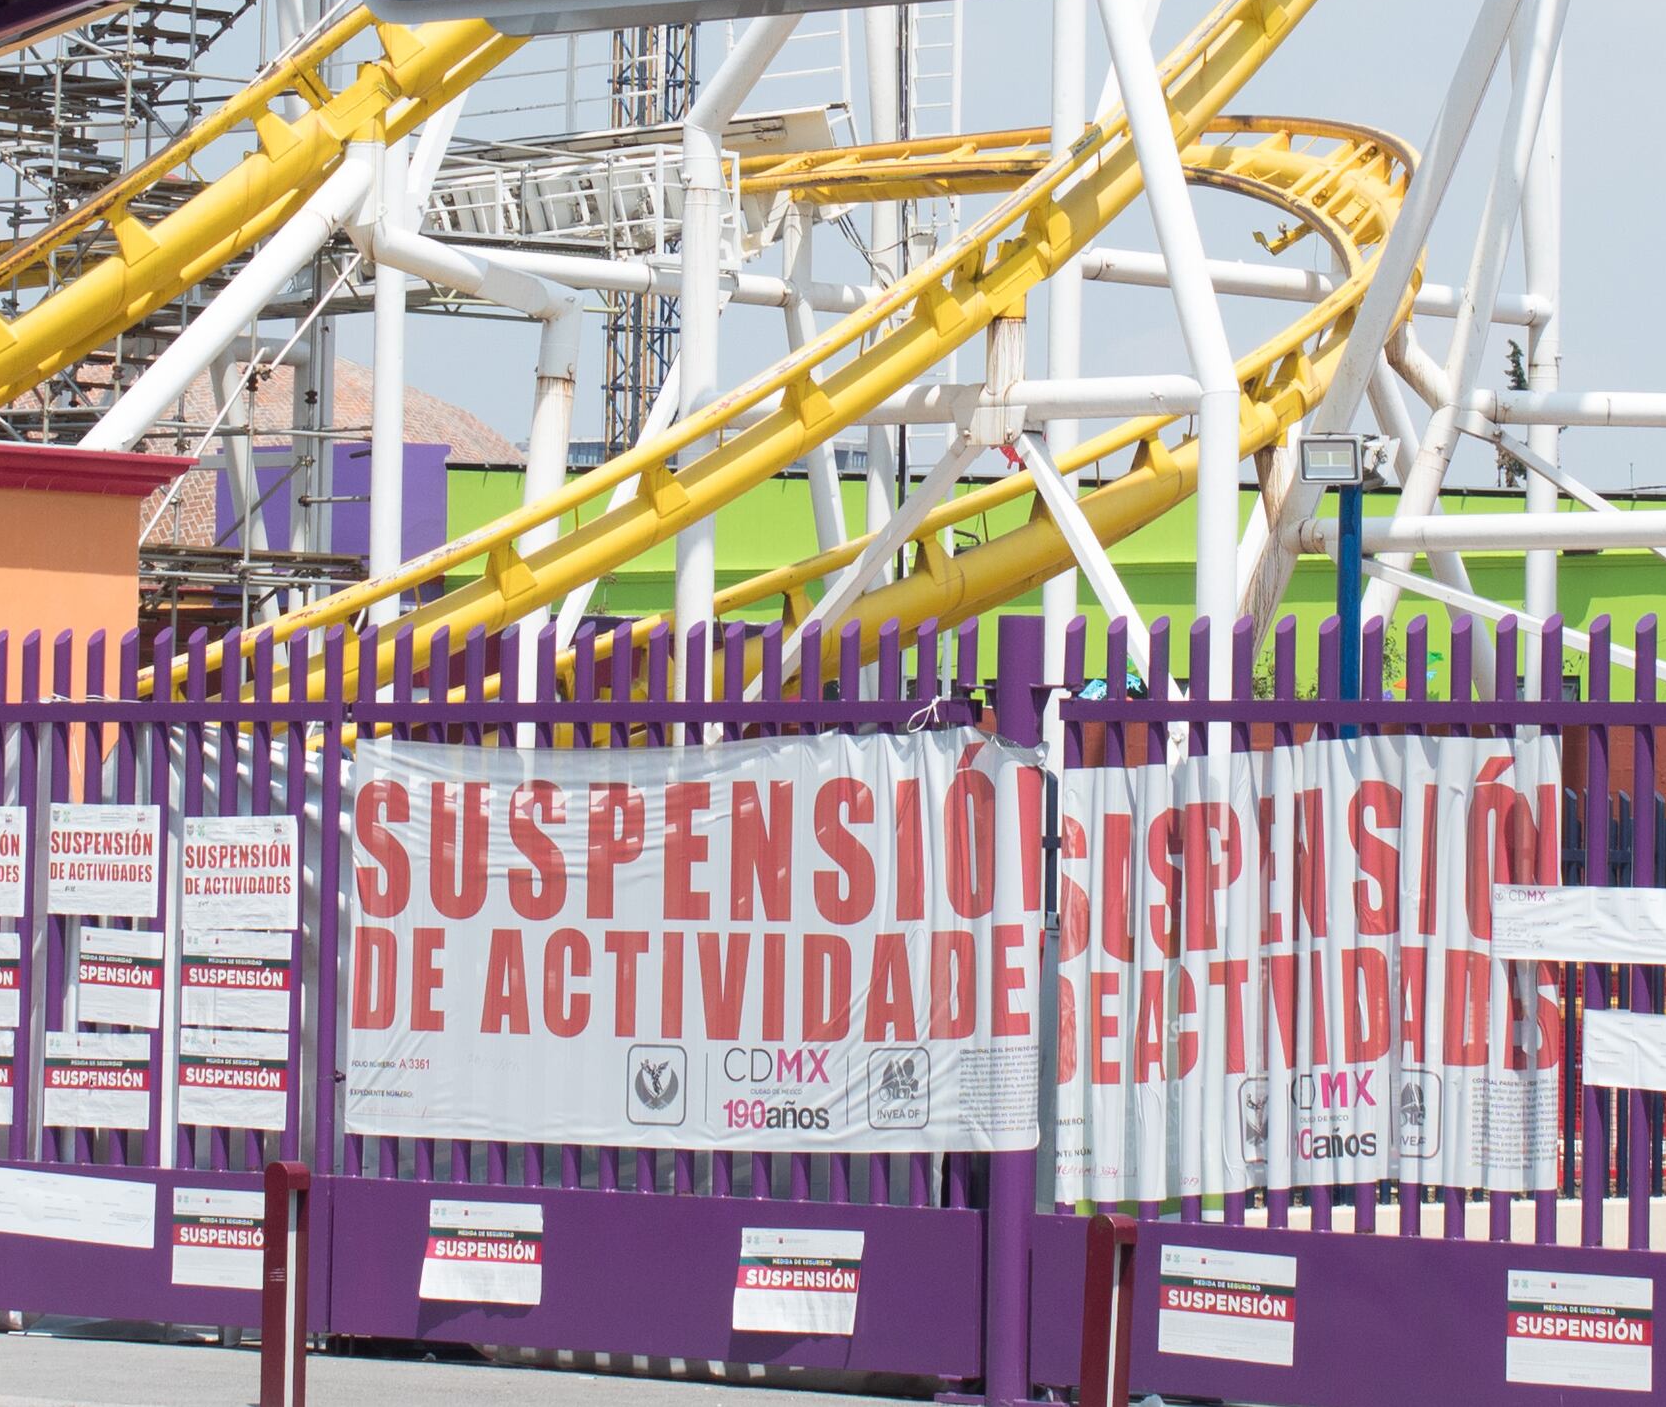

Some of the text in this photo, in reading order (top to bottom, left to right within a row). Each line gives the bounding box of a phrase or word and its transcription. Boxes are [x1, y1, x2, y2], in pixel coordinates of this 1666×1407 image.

[51, 828, 152, 856] SUSPENSIÓN
[185, 840, 290, 869] SUSPENSIÓN
[50, 862, 152, 883] DE ACTIVIDADES
[185, 876, 290, 895] DE ACTIVIDADES
[1508, 889, 1546, 902] CDMX
[189, 967, 283, 987] SUSPENSIÓN
[351, 926, 445, 1033] DE
[399, 1058, 407, 1069] A
[724, 1048, 829, 1084] CDMX
[52, 1068, 143, 1088] SUSPENSIÓN
[185, 1067, 280, 1087] SUSPENSIÓN
[723, 1098, 830, 1130] 190años
[877, 1109, 920, 1120] INVEA DF
[180, 1227, 264, 1246] SUSPENSIÓ
[435, 1240, 535, 1260] SUSPENSIÓN
[745, 1268, 855, 1289] SUSPENSIÓN
[1168, 1289, 1286, 1317] SUSPENSIÓN
[1516, 1316, 1643, 1341] SUSPENSIÓN
